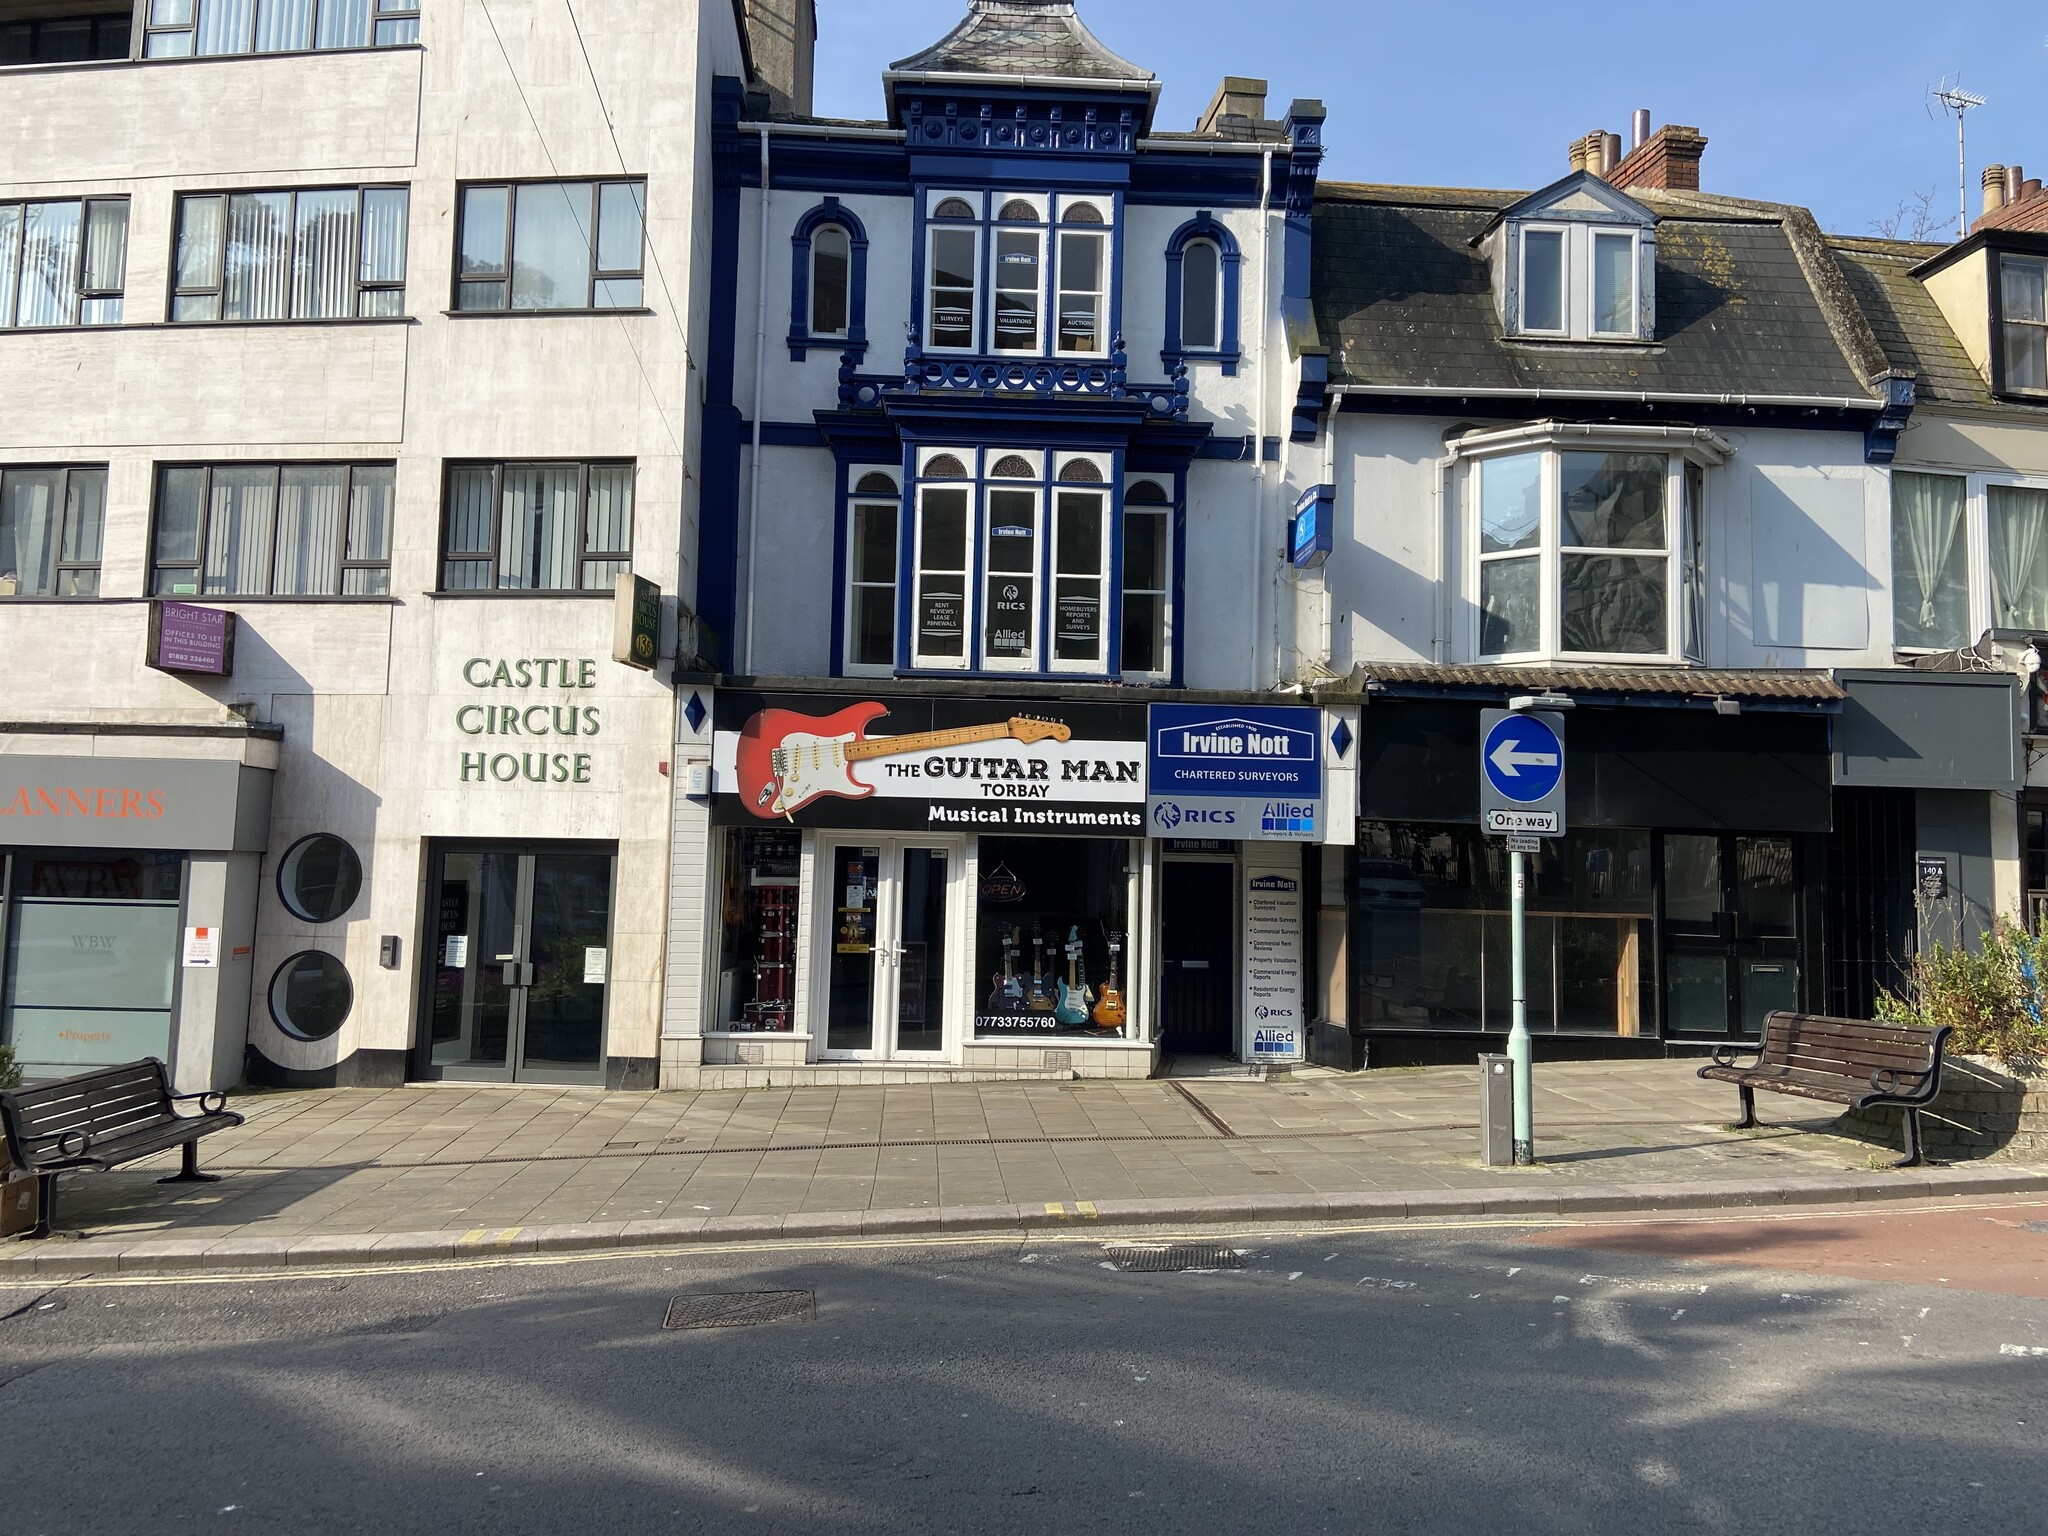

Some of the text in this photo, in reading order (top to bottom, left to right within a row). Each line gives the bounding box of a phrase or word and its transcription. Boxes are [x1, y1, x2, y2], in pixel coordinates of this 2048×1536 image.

[1000, 317, 1032, 325] VALUATIONS
[997, 602, 1026, 610] RICS
[165, 606, 223, 625] BRIGHT STAR
[635, 612, 656, 631] HOUSE
[165, 629, 195, 639] OFFICES
[198, 633, 208, 641] TO
[994, 629, 1025, 639] Allied
[174, 637, 188, 646] THIS
[190, 640, 221, 649] BUILDING
[463, 657, 597, 688] CASTLE
[456, 705, 601, 736] CIRCUS
[1215, 723, 1245, 731] ESTABLISHED
[1183, 732, 1290, 756] Irvine Nott
[460, 752, 592, 782] HOUSE
[885, 756, 1142, 783] THE GUITAR MAN
[1174, 770, 1299, 782] CHARTERED SURVEYORS
[980, 783, 1050, 798] TORBAY
[928, 805, 1142, 826] Musical Instruments
[1262, 802, 1314, 818] Allied
[1185, 810, 1236, 824] RICS
[1494, 814, 1552, 829] One way
[1173, 840, 1219, 850] Irvine Nott
[1924, 867, 1943, 875] 140 A
[982, 884, 1022, 894] OPEN
[1252, 880, 1295, 889] Irvine Nott
[1517, 880, 1524, 889] 5
[72, 934, 117, 948] WBW
[976, 1016, 1056, 1028] 07733755760
[65, 1029, 112, 1044] Property
[1254, 1030, 1294, 1042] Allied
